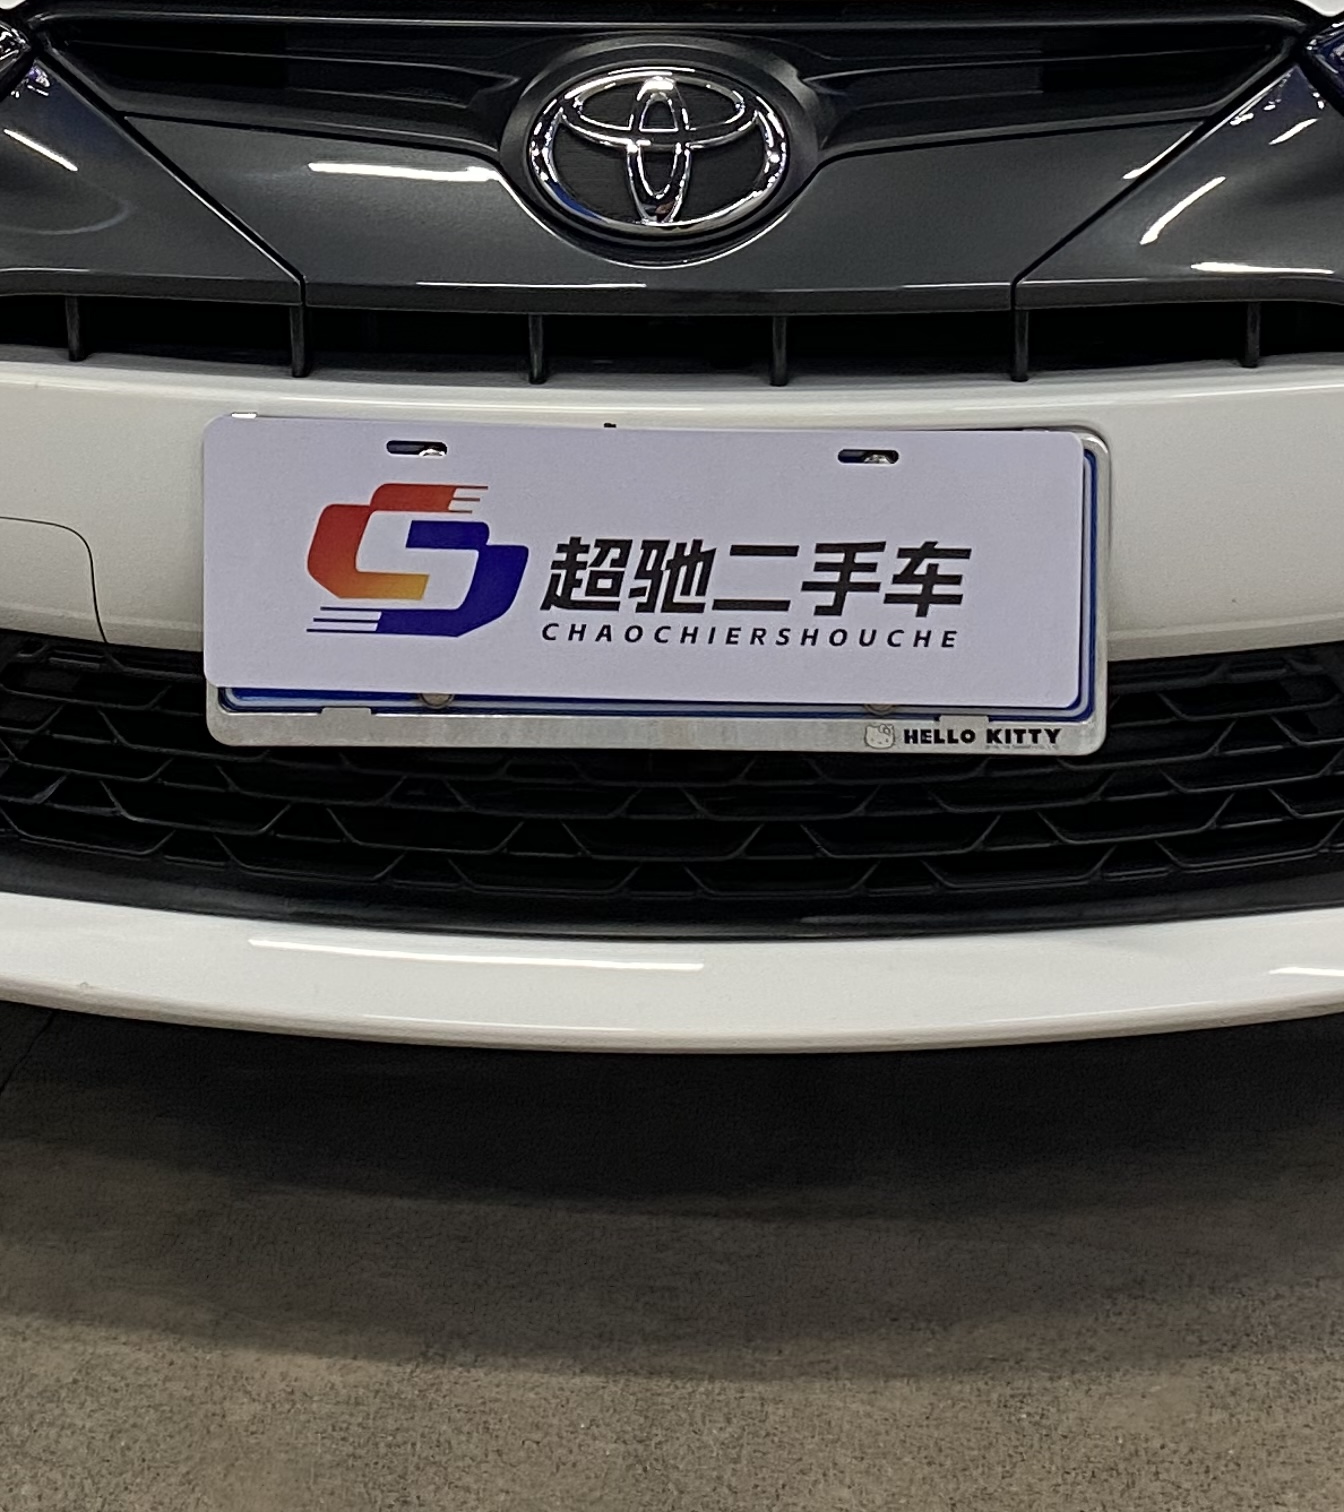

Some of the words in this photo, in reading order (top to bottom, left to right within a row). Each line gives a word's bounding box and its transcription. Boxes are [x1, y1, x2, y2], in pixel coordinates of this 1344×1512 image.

[539, 535, 973, 618] 超驰二手车
[540, 622, 958, 649] CHAOCHIERSHOUCHE
[903, 728, 977, 744] HELLO
[986, 728, 1062, 745] KITTY
